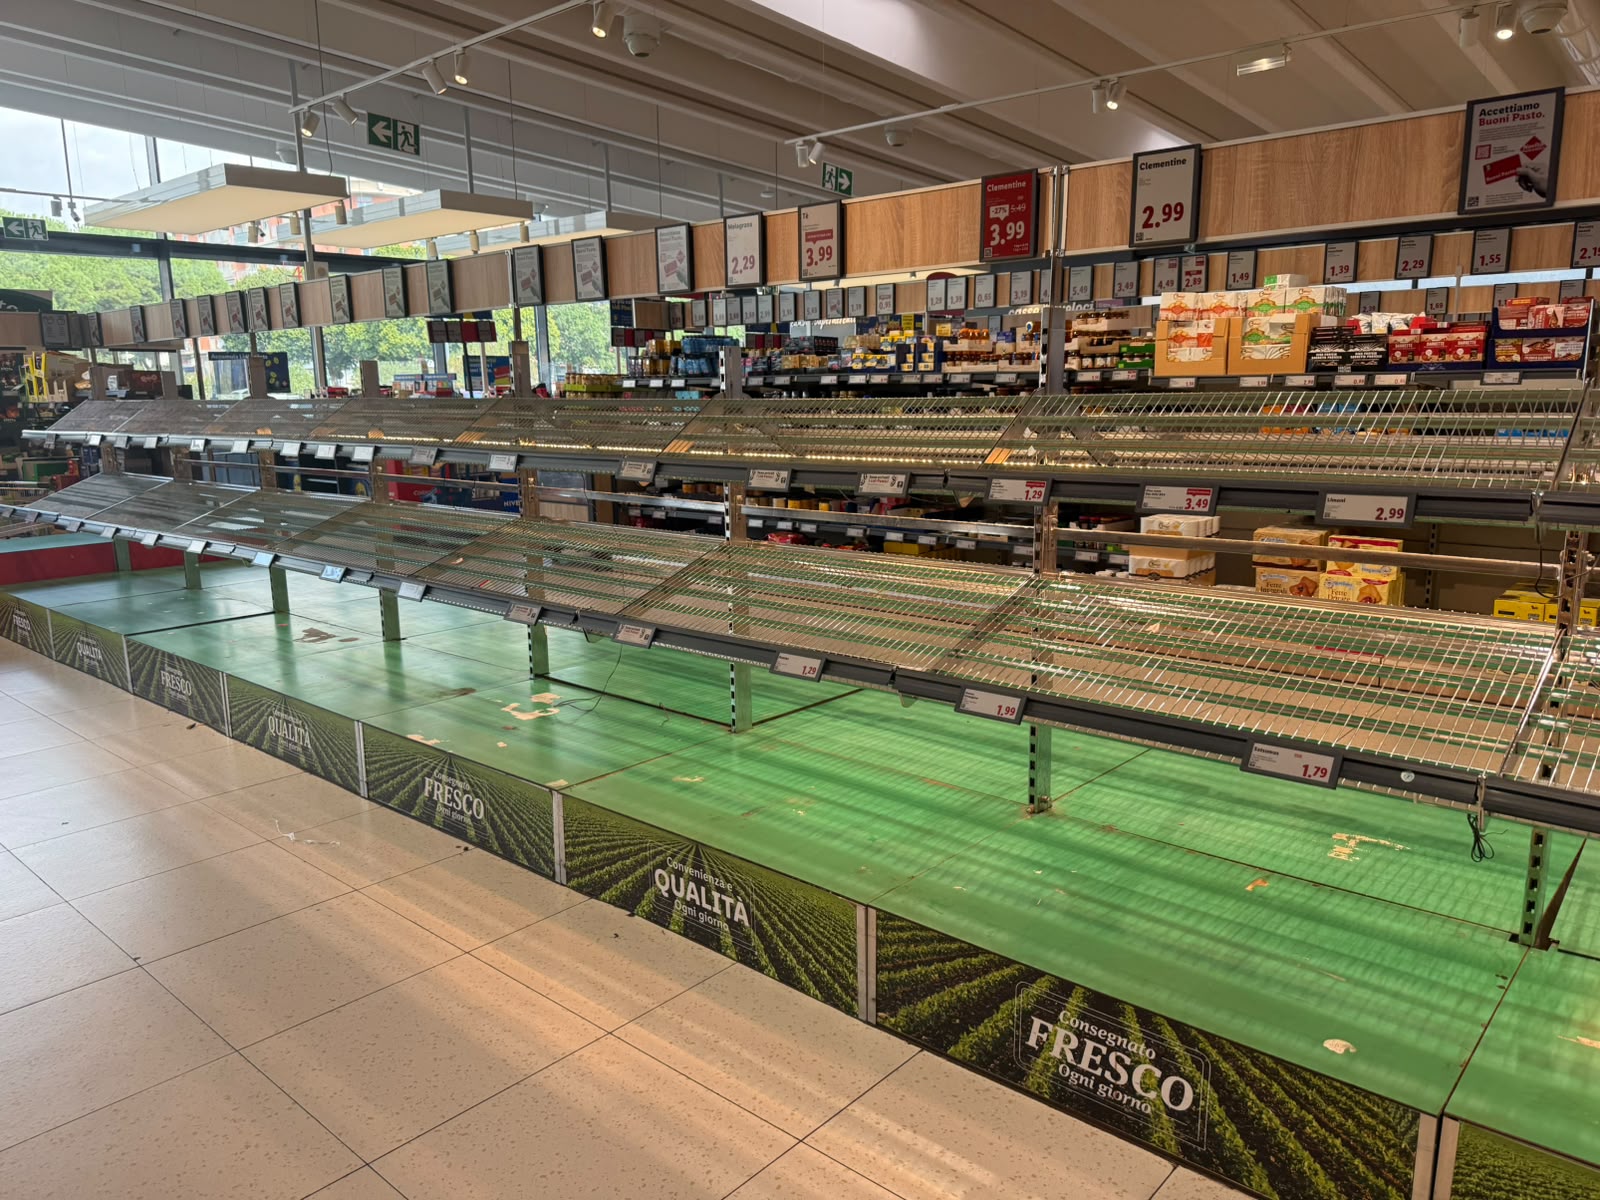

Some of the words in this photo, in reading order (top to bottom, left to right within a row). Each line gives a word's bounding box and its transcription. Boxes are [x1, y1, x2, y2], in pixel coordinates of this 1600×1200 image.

[1479, 103, 1540, 117] Accettiamo
[1479, 114, 1509, 126] Buoni
[1512, 111, 1545, 122] Pasto.
[1139, 157, 1187, 171] Clementine
[987, 180, 1027, 192] Clementine
[1142, 202, 1185, 230] 2.99
[990, 221, 1025, 246] 3.99
[807, 245, 833, 267] 3.99
[1480, 254, 1501, 266] 1.55
[732, 255, 755, 275] 2.29
[1330, 265, 1350, 277] 1.39
[1402, 260, 1425, 271] 2.29
[1158, 280, 1175, 289] 4.49
[1232, 272, 1250, 283] 1.49
[1072, 285, 1089, 296] 5.49
[1117, 281, 1135, 292] 3.49
[1025, 489, 1043, 501] 1.29
[1184, 498, 1209, 510] 3.49
[1375, 507, 1405, 521] 2.99
[802, 665, 817, 675] 1.29
[160, 670, 192, 696] FRESCO
[996, 704, 1016, 716] 1.99
[1302, 764, 1328, 778] 1.79
[424, 777, 485, 819] FRESCO
[666, 856, 726, 888] Convenienza
[727, 882, 734, 892] e
[654, 868, 750, 928] QUALITÀ
[674, 899, 697, 917] Ogni
[698, 911, 730, 932] giorno
[1058, 1009, 1157, 1060] Consegnato
[1024, 1015, 1195, 1112] FRESCO
[1058, 1062, 1095, 1090] Ogni
[1096, 1082, 1152, 1114] giorno
